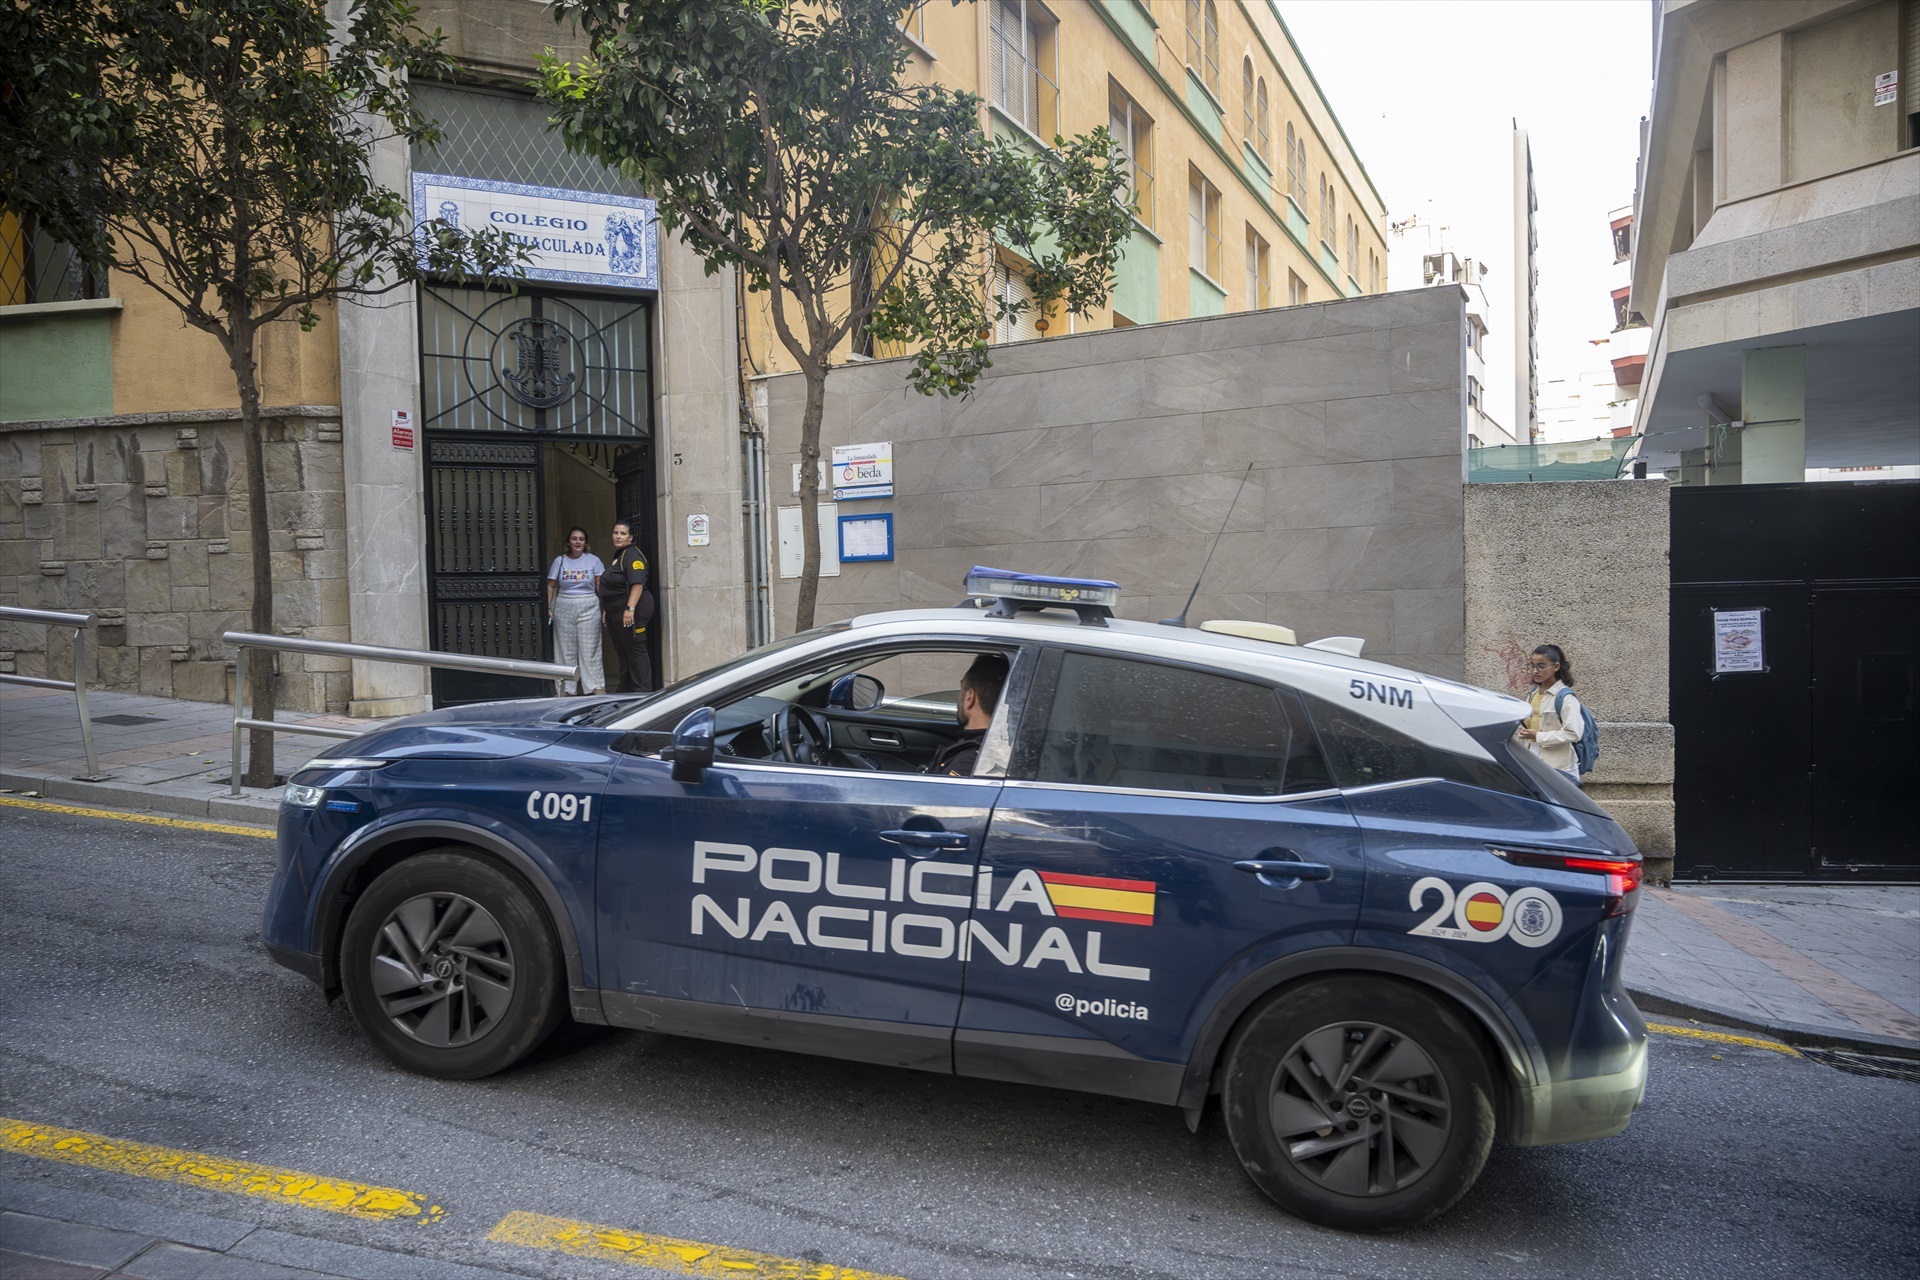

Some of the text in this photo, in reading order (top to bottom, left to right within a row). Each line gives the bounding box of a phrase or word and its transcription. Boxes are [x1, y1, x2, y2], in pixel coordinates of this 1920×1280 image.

[489, 211, 588, 231] COLEGIO
[857, 465, 882, 479] beda
[1349, 678, 1413, 710] 5NM
[543, 792, 592, 822] 091
[1406, 876, 1563, 948] 200
[691, 894, 1151, 981] NACIONAL
[1055, 993, 1149, 1020] @policia
